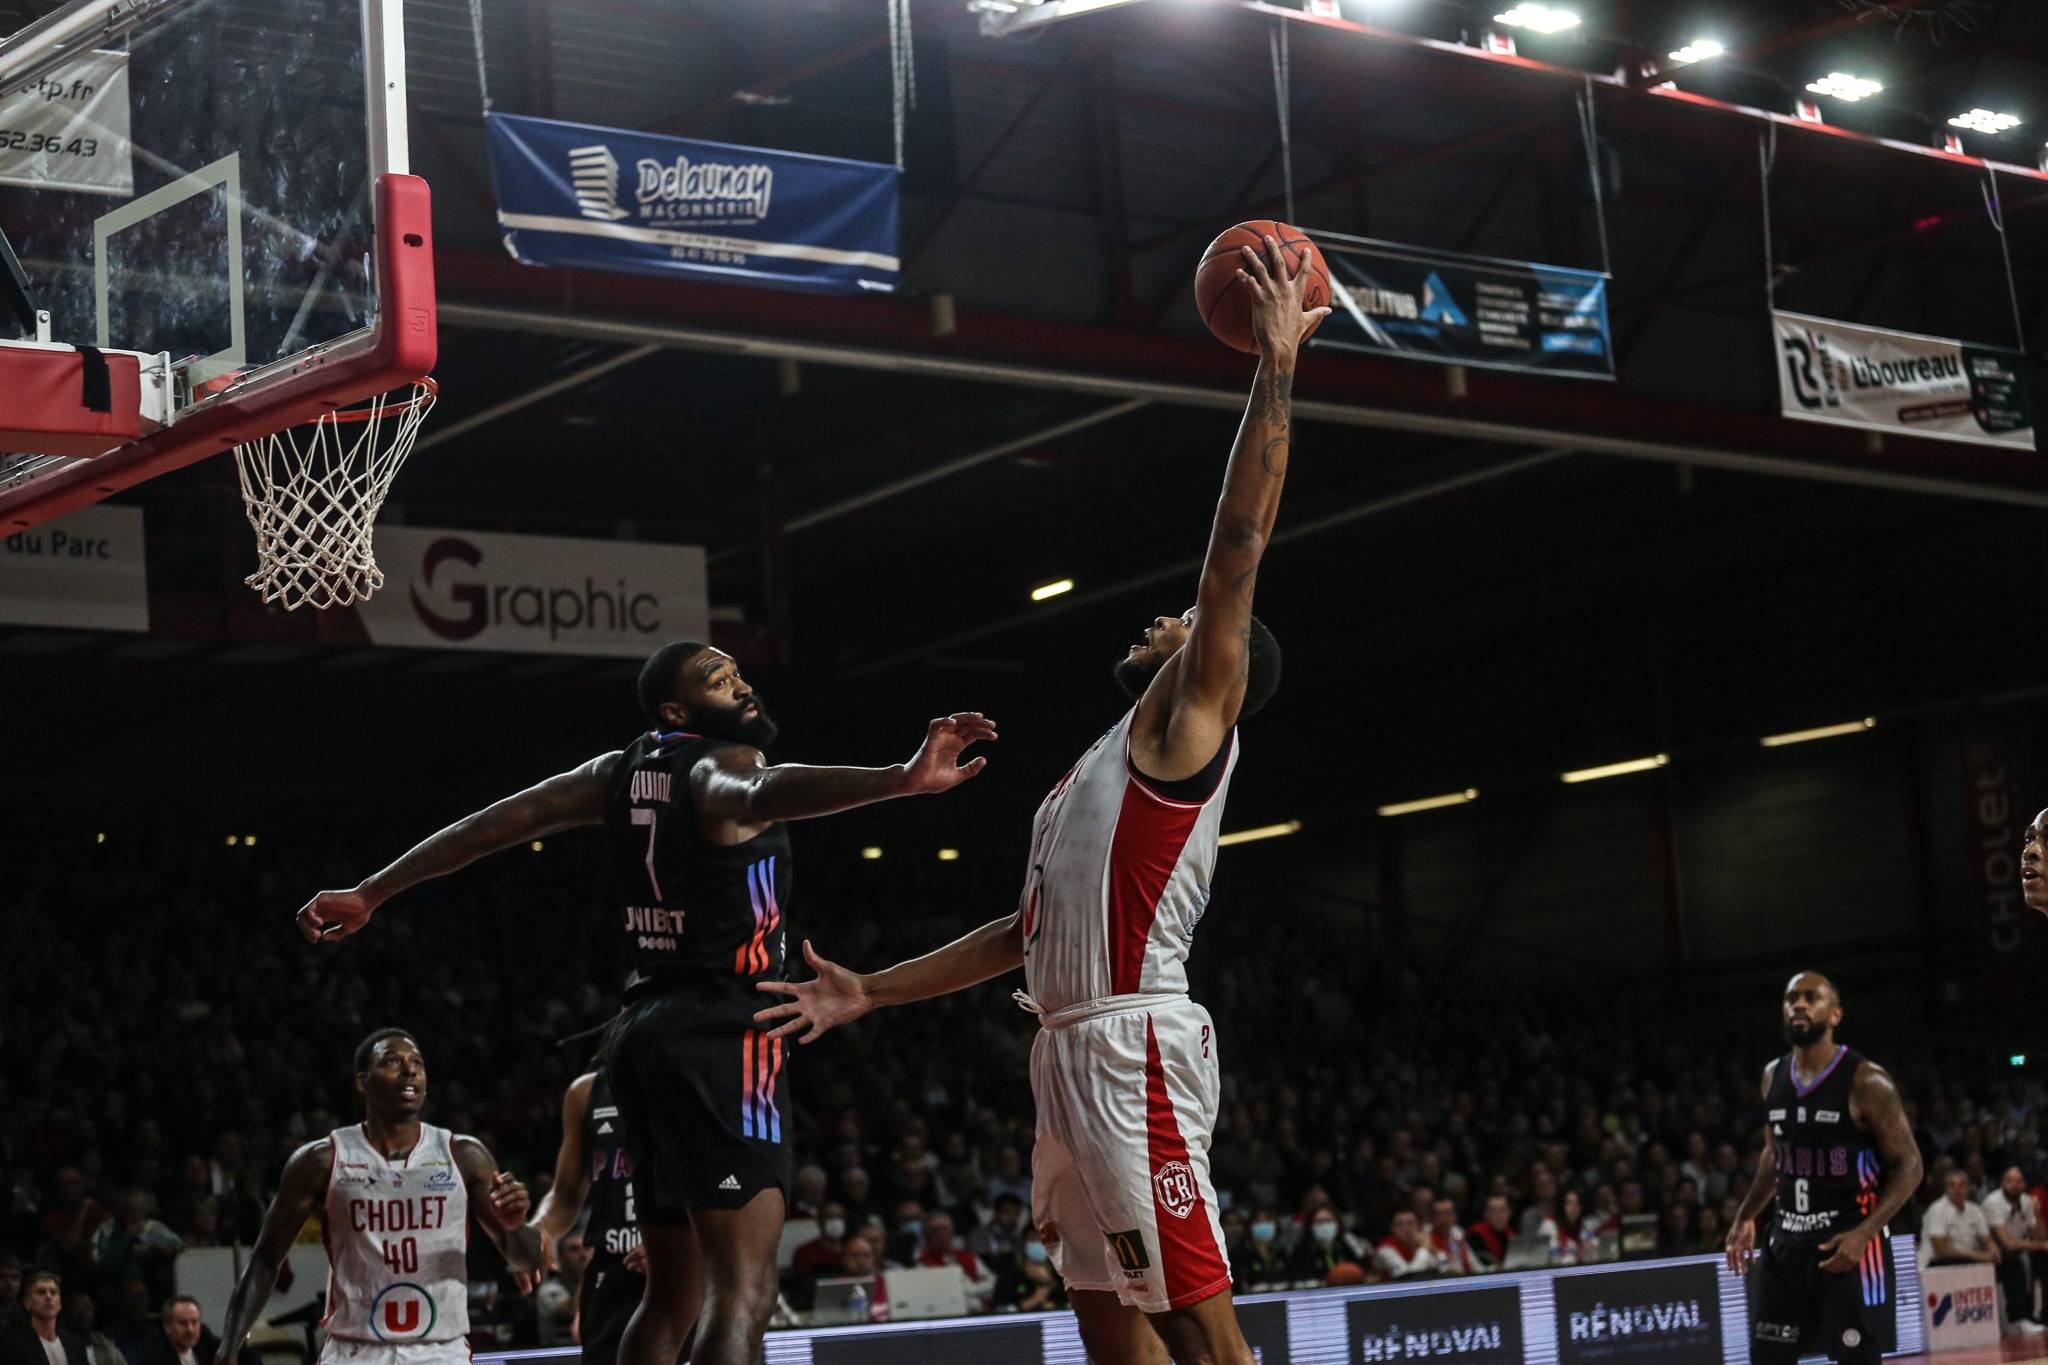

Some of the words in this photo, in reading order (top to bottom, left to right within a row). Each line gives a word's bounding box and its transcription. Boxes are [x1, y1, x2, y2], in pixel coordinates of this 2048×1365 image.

[635, 155, 773, 219] Delaunay
[1850, 353, 1959, 389] Liboureau
[7, 532, 41, 554] du
[52, 529, 110, 558] Parc
[408, 537, 661, 641] Graphic
[630, 808, 663, 902] 7
[1162, 1172, 1193, 1207] CB
[1794, 1178, 1810, 1214] 6
[350, 1196, 447, 1232] CHOLET
[383, 1237, 418, 1274] 40
[1954, 1286, 1993, 1306] INTER
[1956, 1303, 1994, 1326] SPORT
